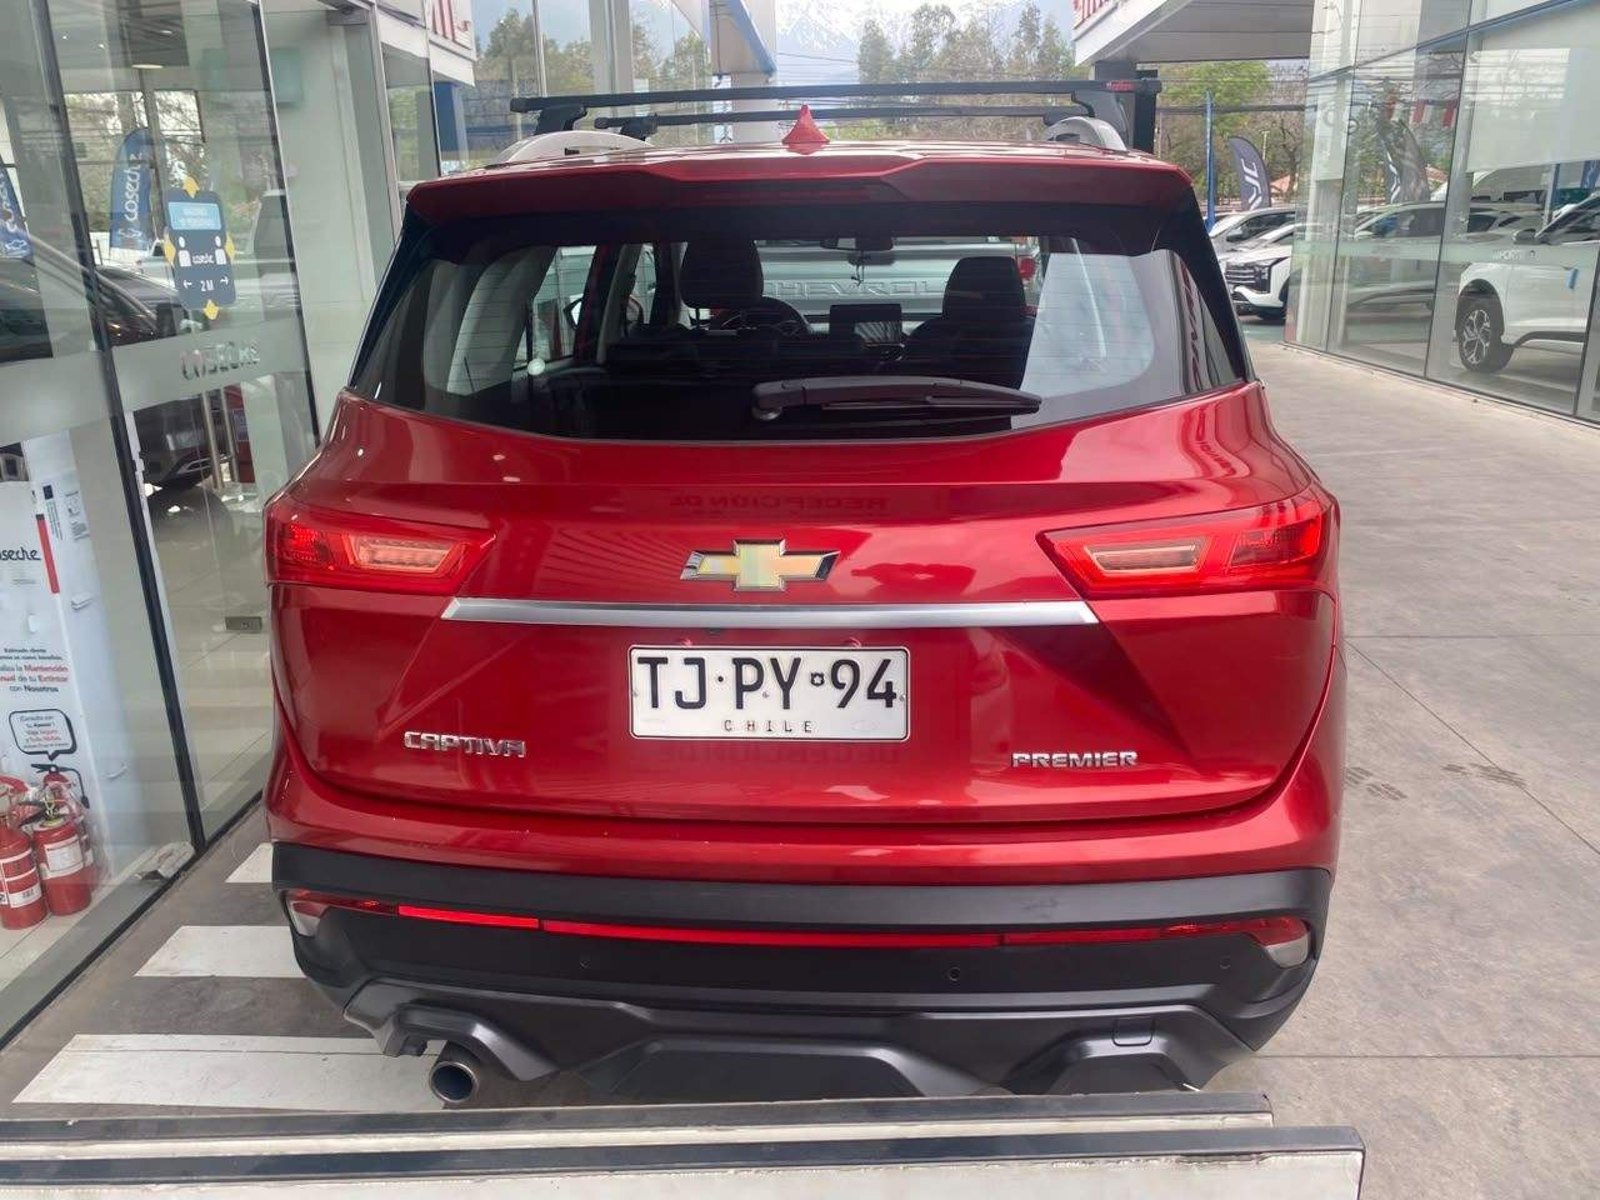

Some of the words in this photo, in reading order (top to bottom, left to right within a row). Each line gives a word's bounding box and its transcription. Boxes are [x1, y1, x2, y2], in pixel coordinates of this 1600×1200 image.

[0, 546, 42, 561] seche
[724, 719, 813, 733] CHILE
[404, 731, 526, 758] CAPTIVA
[1012, 750, 1138, 768] PREMIER
